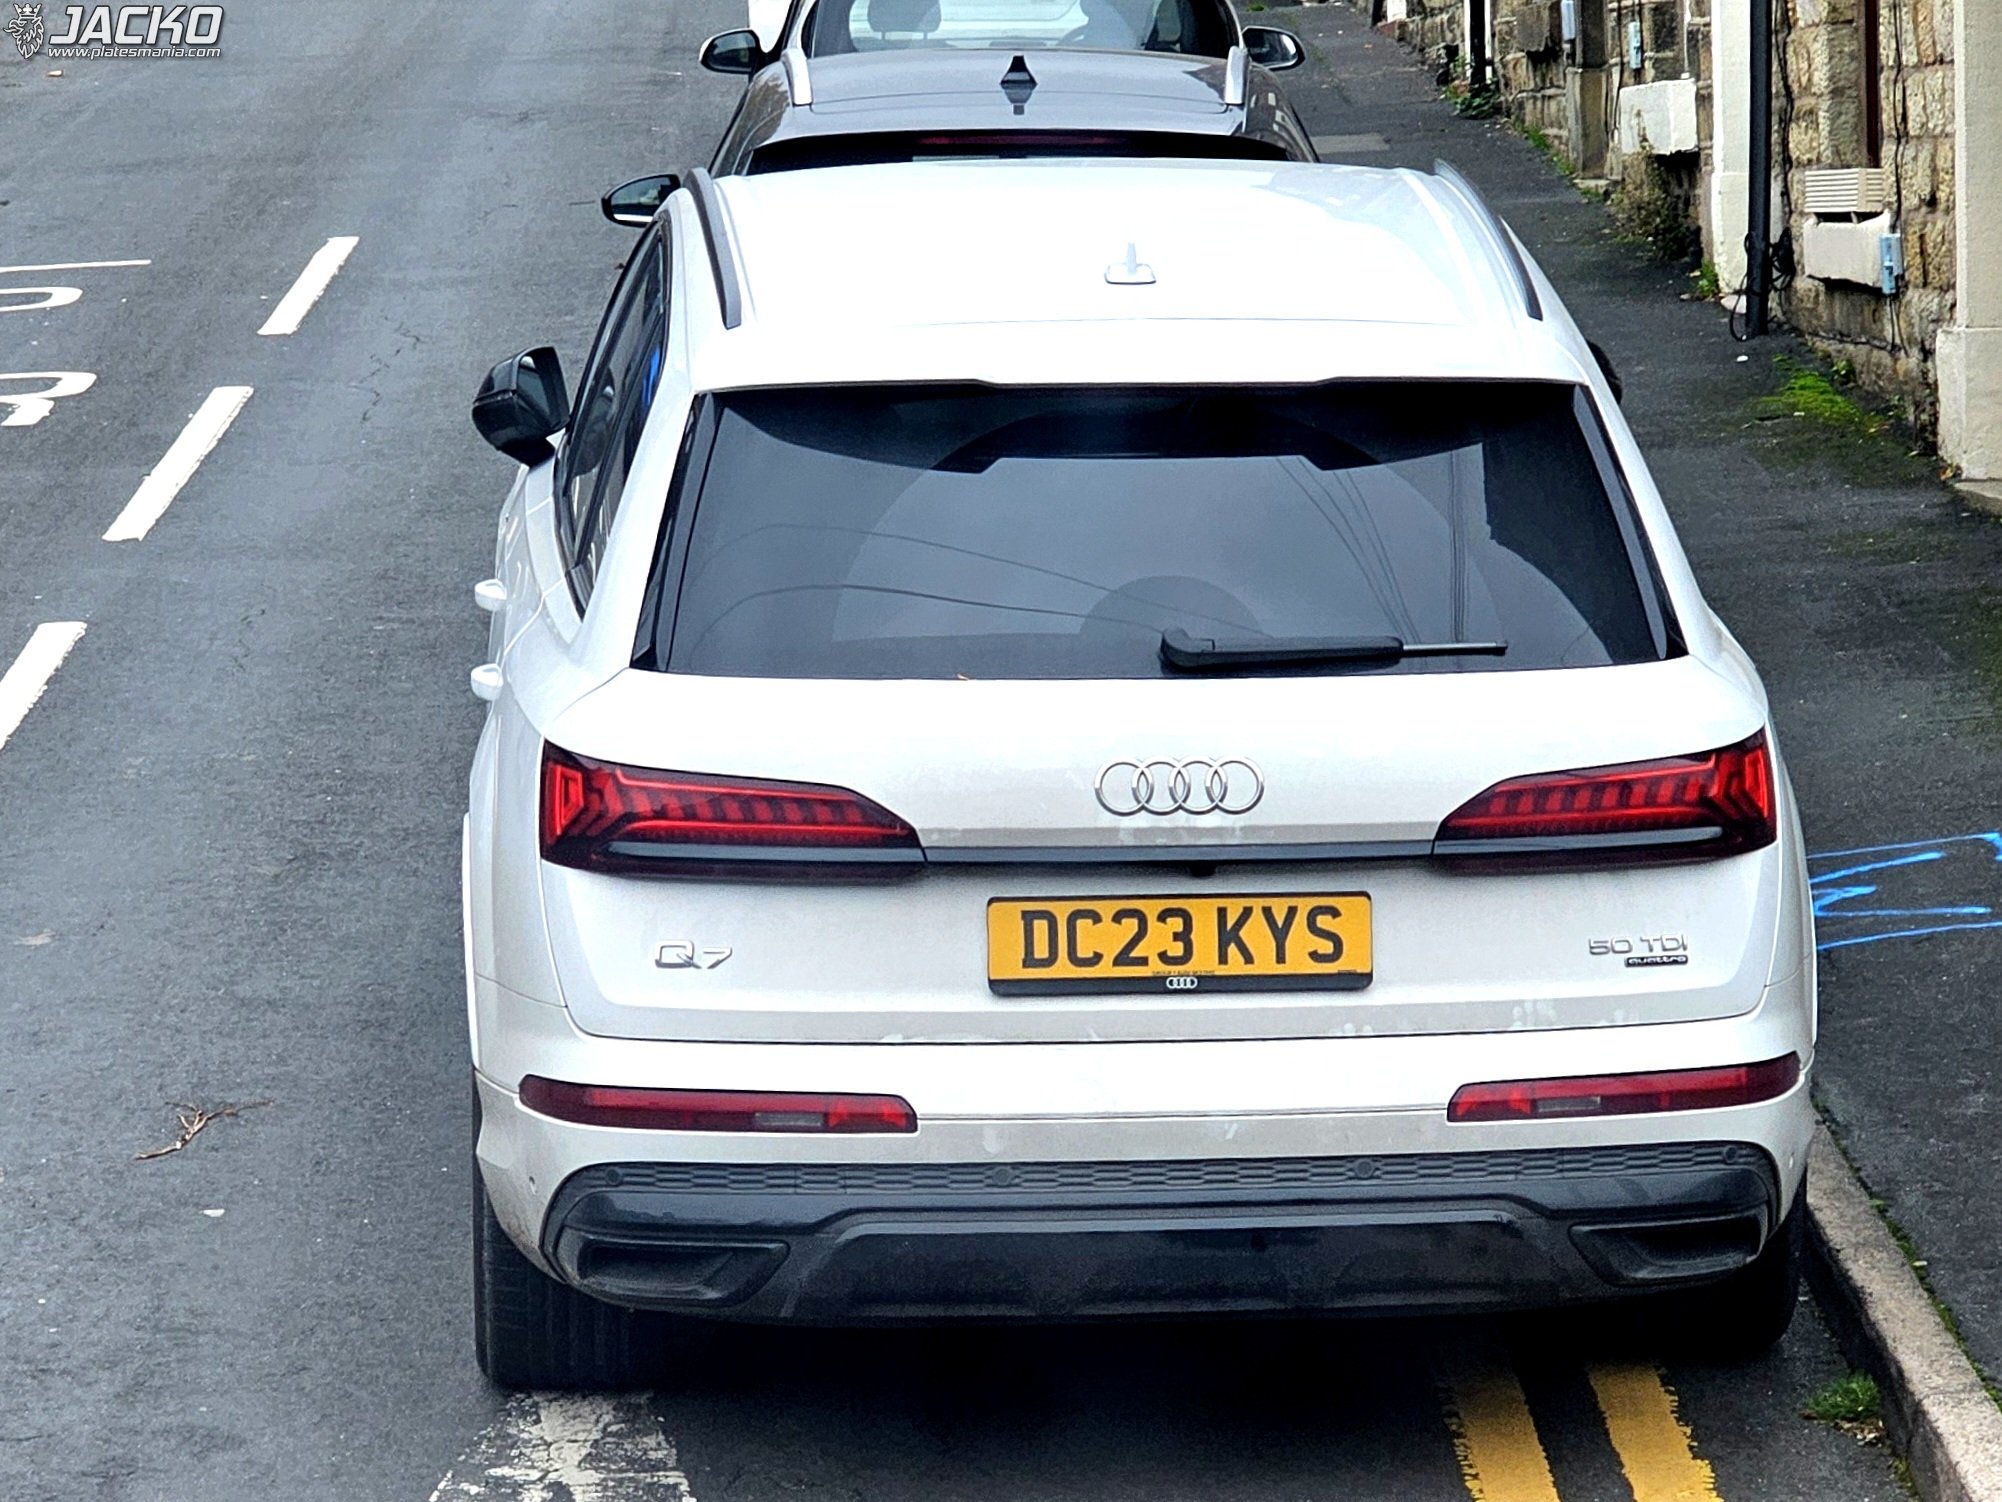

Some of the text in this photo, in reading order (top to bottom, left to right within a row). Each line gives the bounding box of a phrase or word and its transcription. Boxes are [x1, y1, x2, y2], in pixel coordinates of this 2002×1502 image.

[1020, 904, 1345, 970] DC23 KYS
[1588, 934, 1688, 956] 50 TDI
[654, 940, 733, 970] Q7
[1627, 955, 1687, 966] quattro
